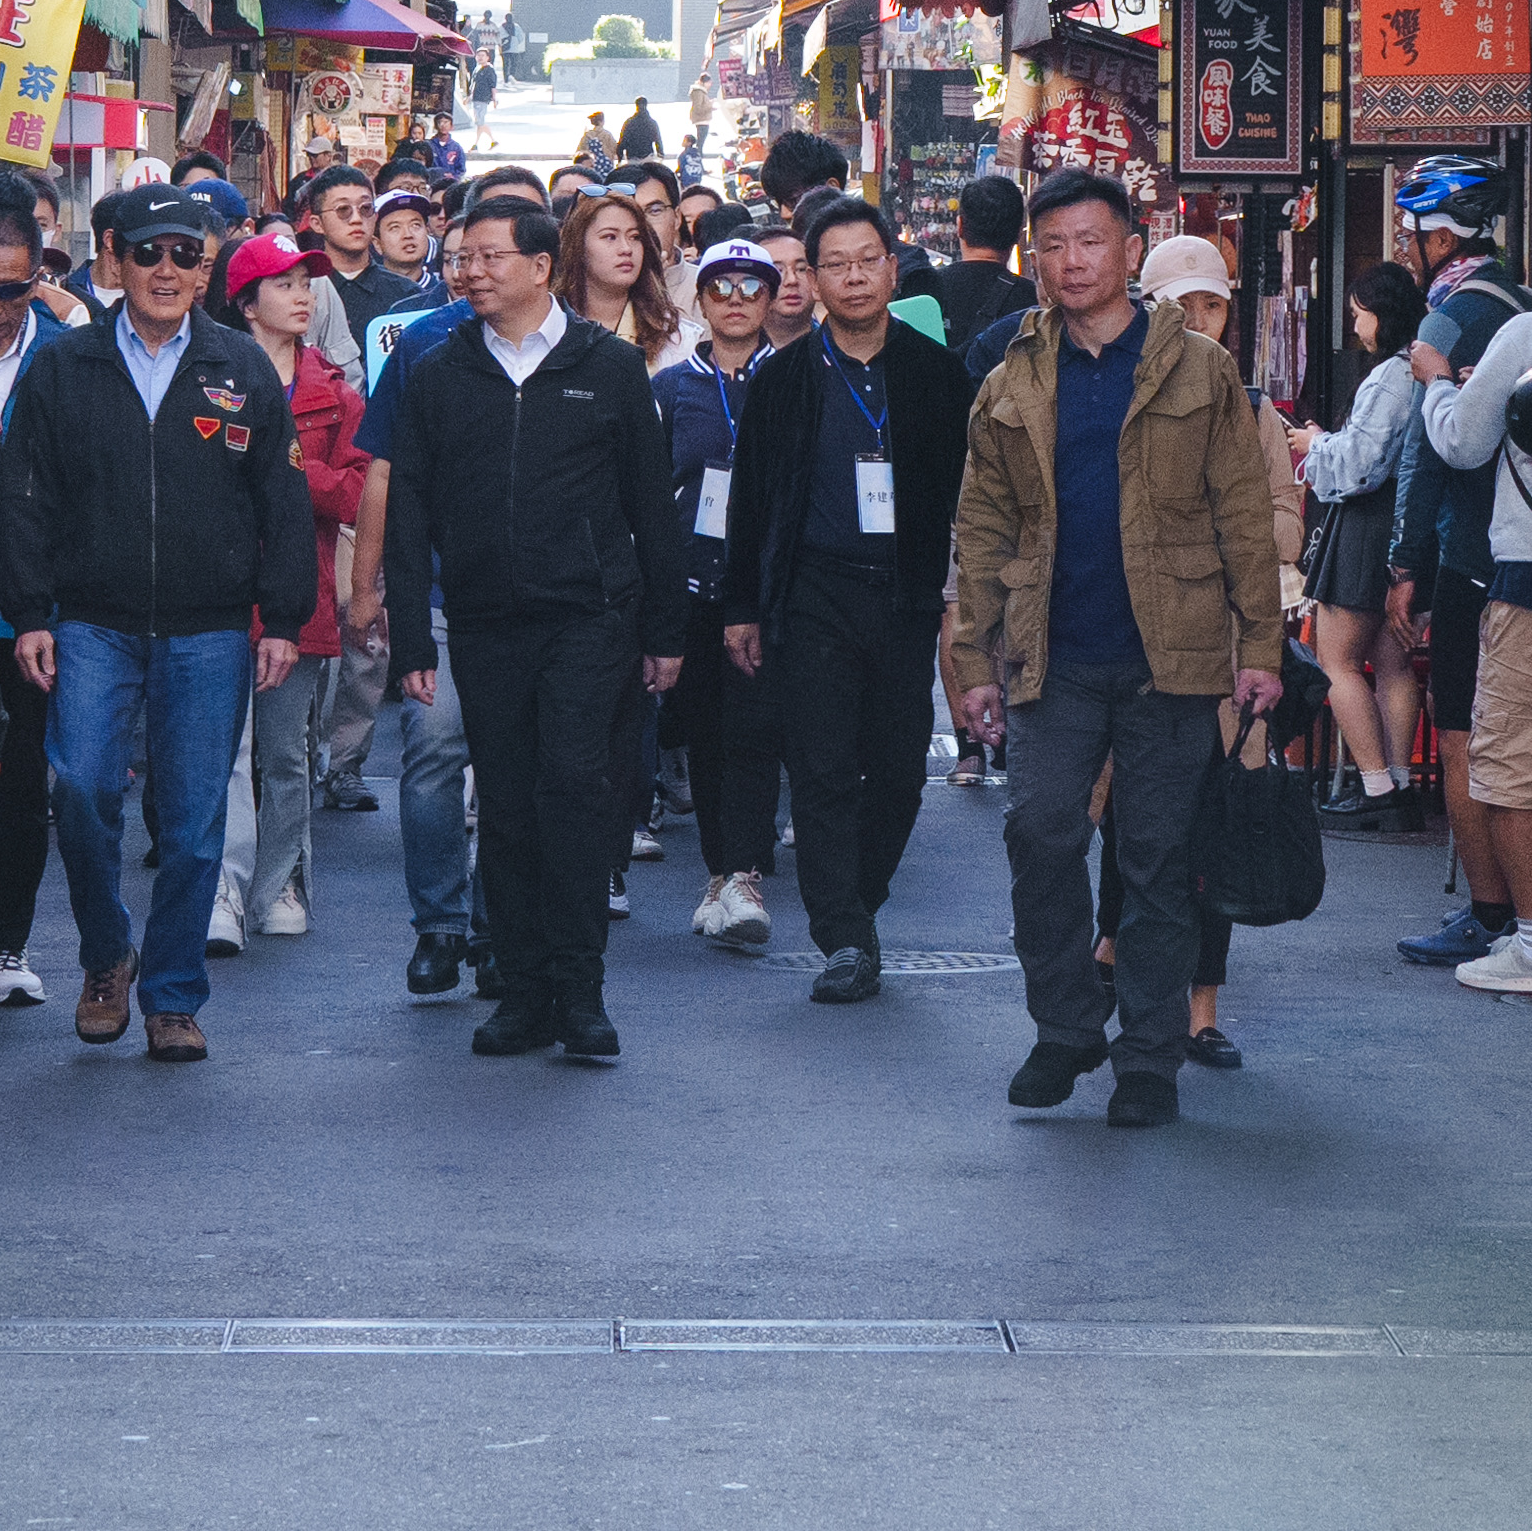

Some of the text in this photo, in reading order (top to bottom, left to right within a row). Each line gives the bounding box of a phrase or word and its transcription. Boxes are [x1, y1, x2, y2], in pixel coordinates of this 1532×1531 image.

[1203, 26, 1231, 37] YUAN
[1208, 40, 1238, 50] FOOD
[1066, 101, 1129, 149] 紅玉
[1413, 199, 1439, 208] GIANT
[563, 389, 595, 397] TOREAD
